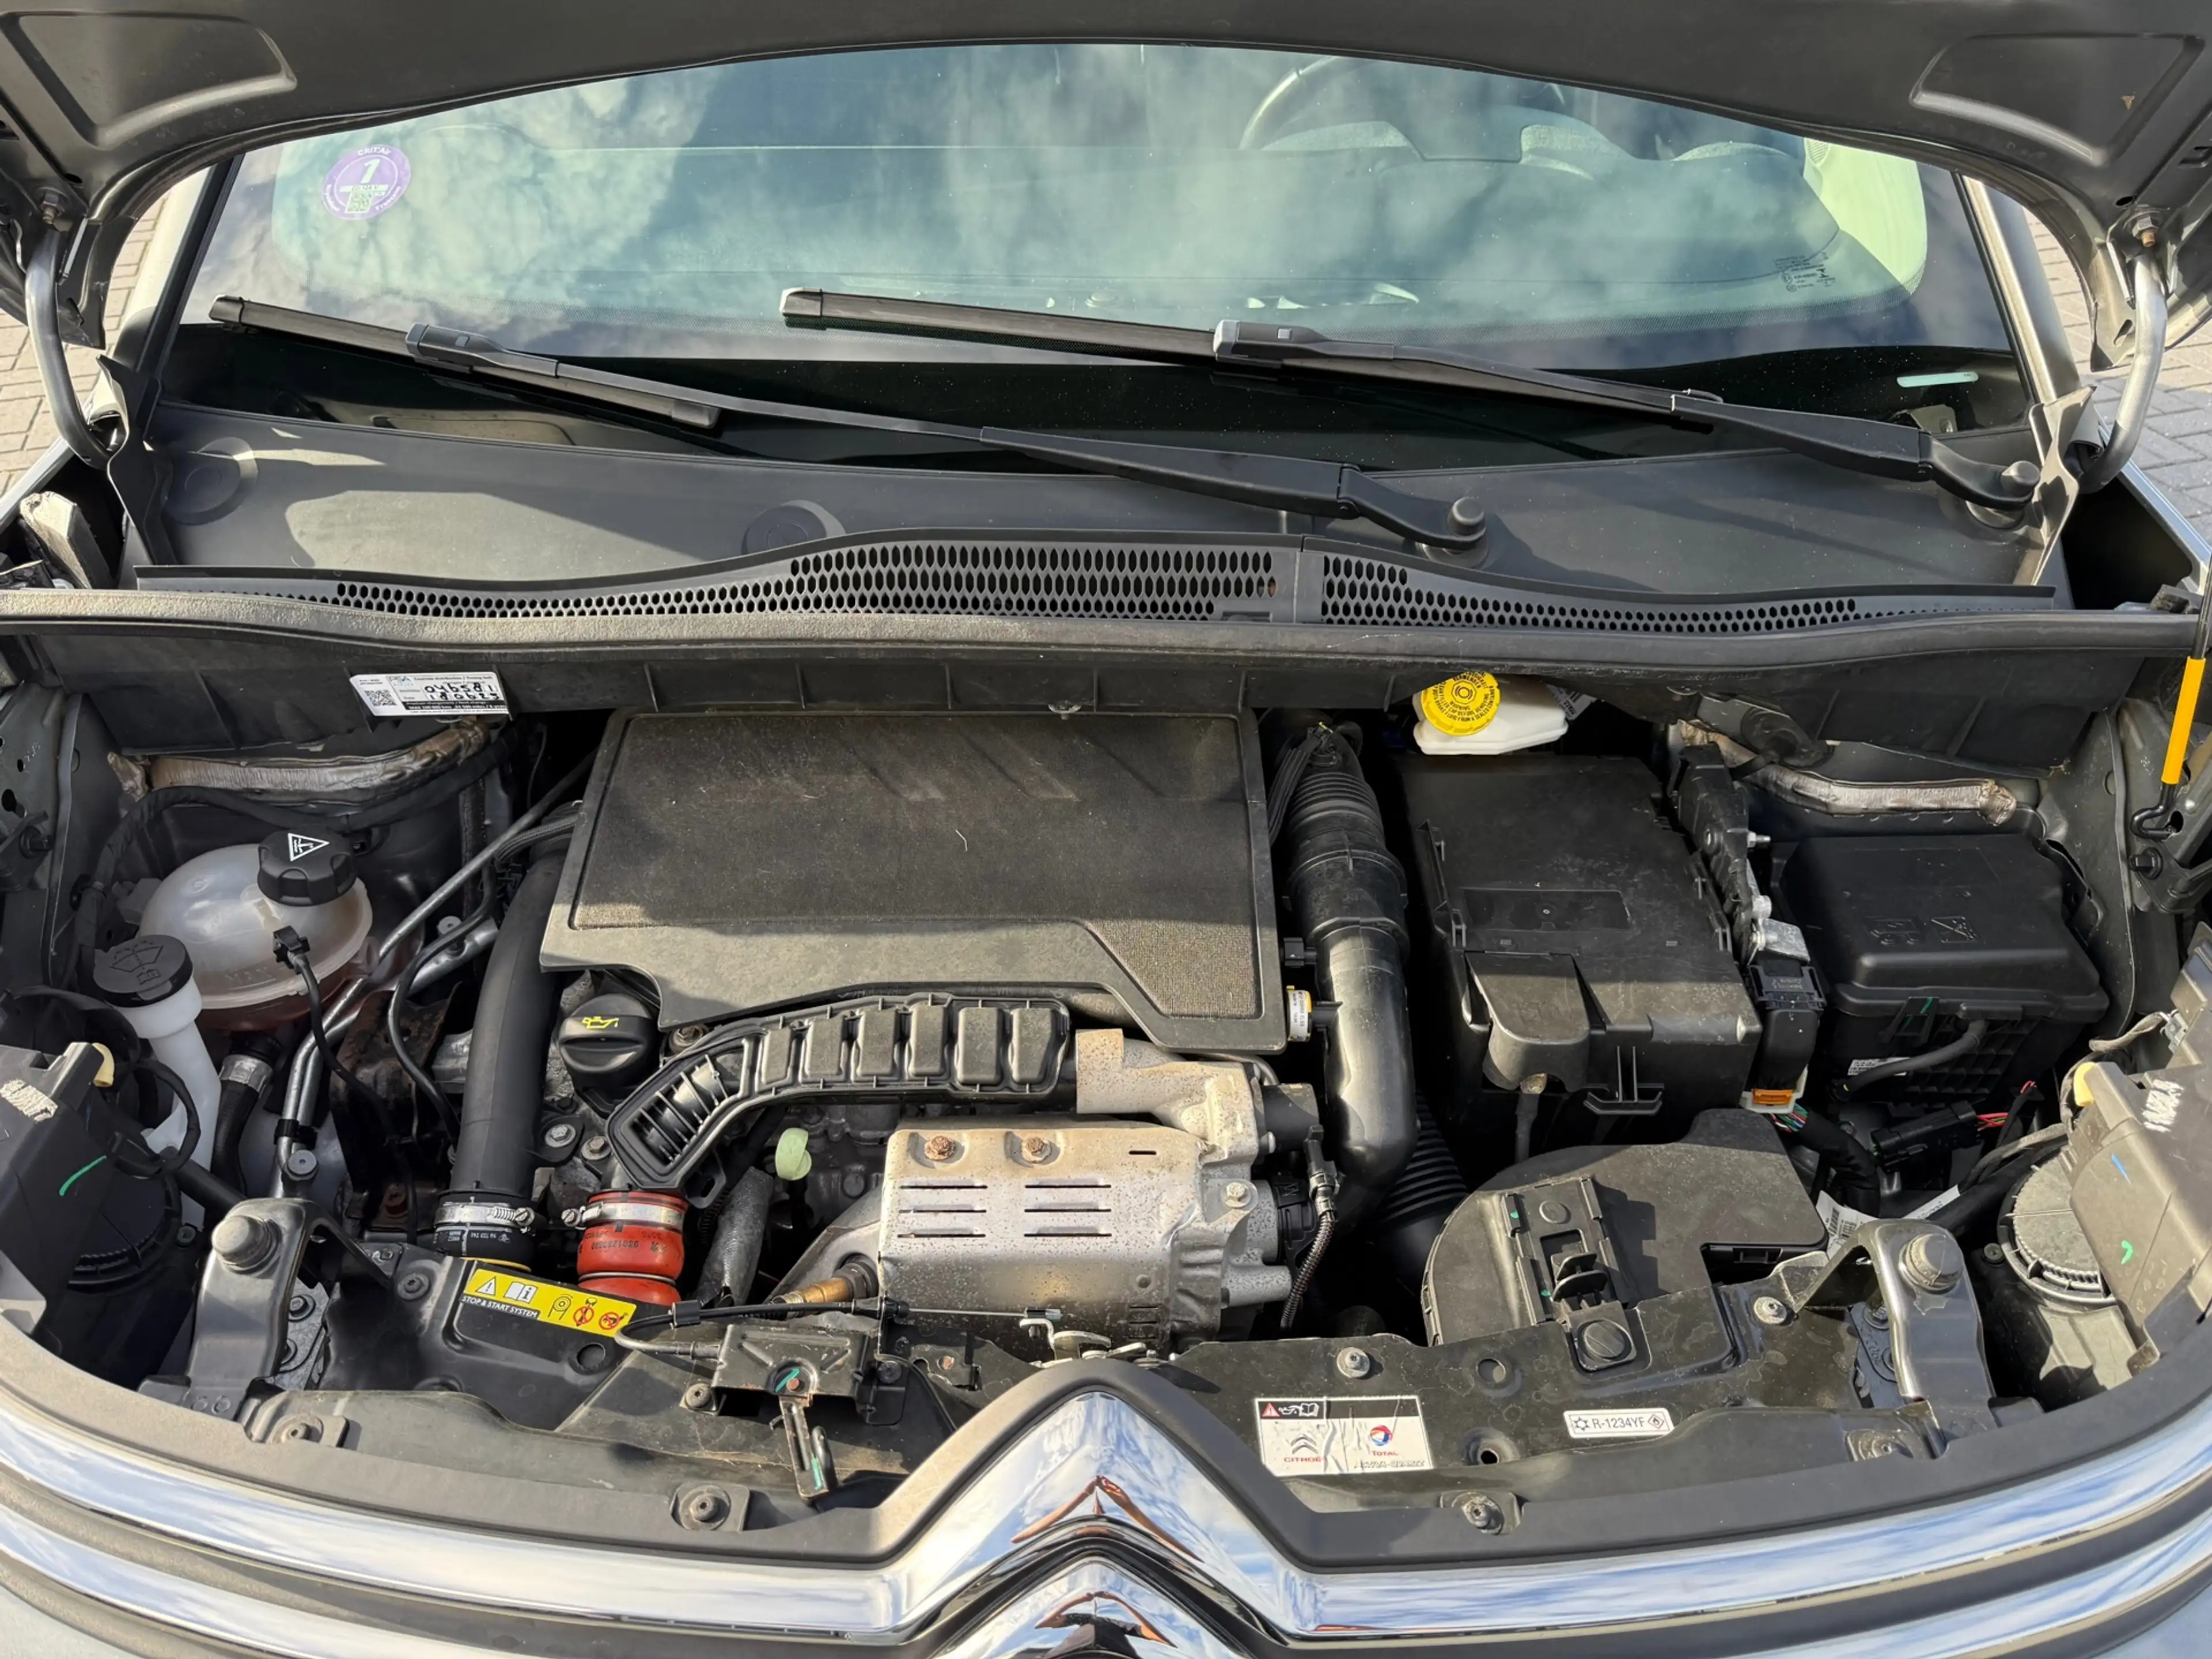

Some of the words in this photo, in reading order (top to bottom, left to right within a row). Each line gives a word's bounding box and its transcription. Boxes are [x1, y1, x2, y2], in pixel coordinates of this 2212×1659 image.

[361, 158, 380, 184] 1
[461, 1294, 481, 1304] STOP
[487, 1301, 509, 1313] START
[509, 1305, 538, 1318] SYSTEM
[1592, 1416, 1646, 1429] R-1234YF
